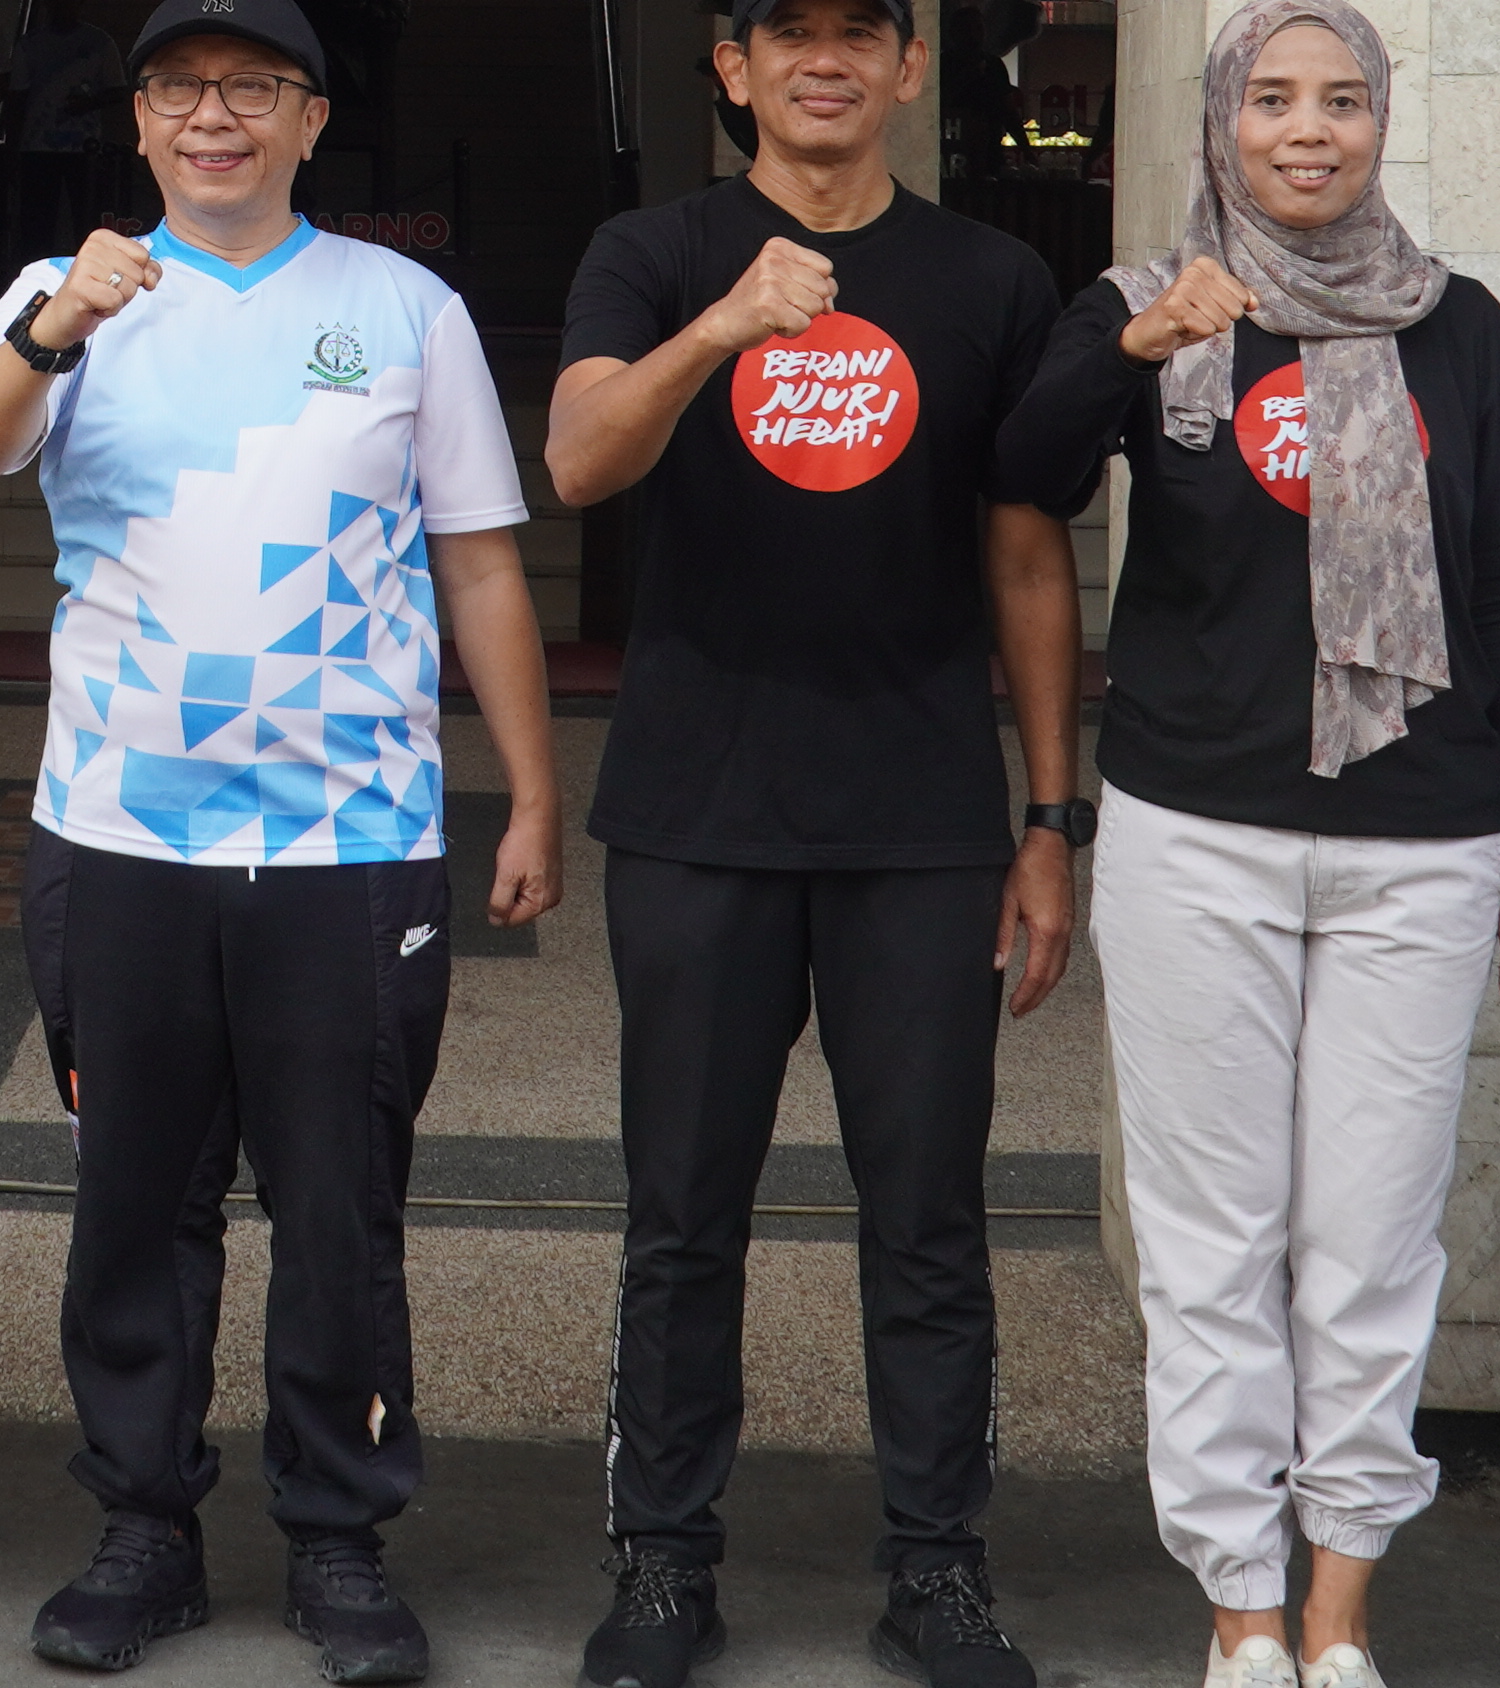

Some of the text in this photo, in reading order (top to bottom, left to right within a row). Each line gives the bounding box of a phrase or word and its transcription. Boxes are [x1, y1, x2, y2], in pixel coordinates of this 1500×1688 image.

[762, 347, 893, 380] BERANI
[750, 380, 882, 417] JUJUR
[749, 389, 900, 450] HEBAT!
[405, 923, 431, 946] NIKE
